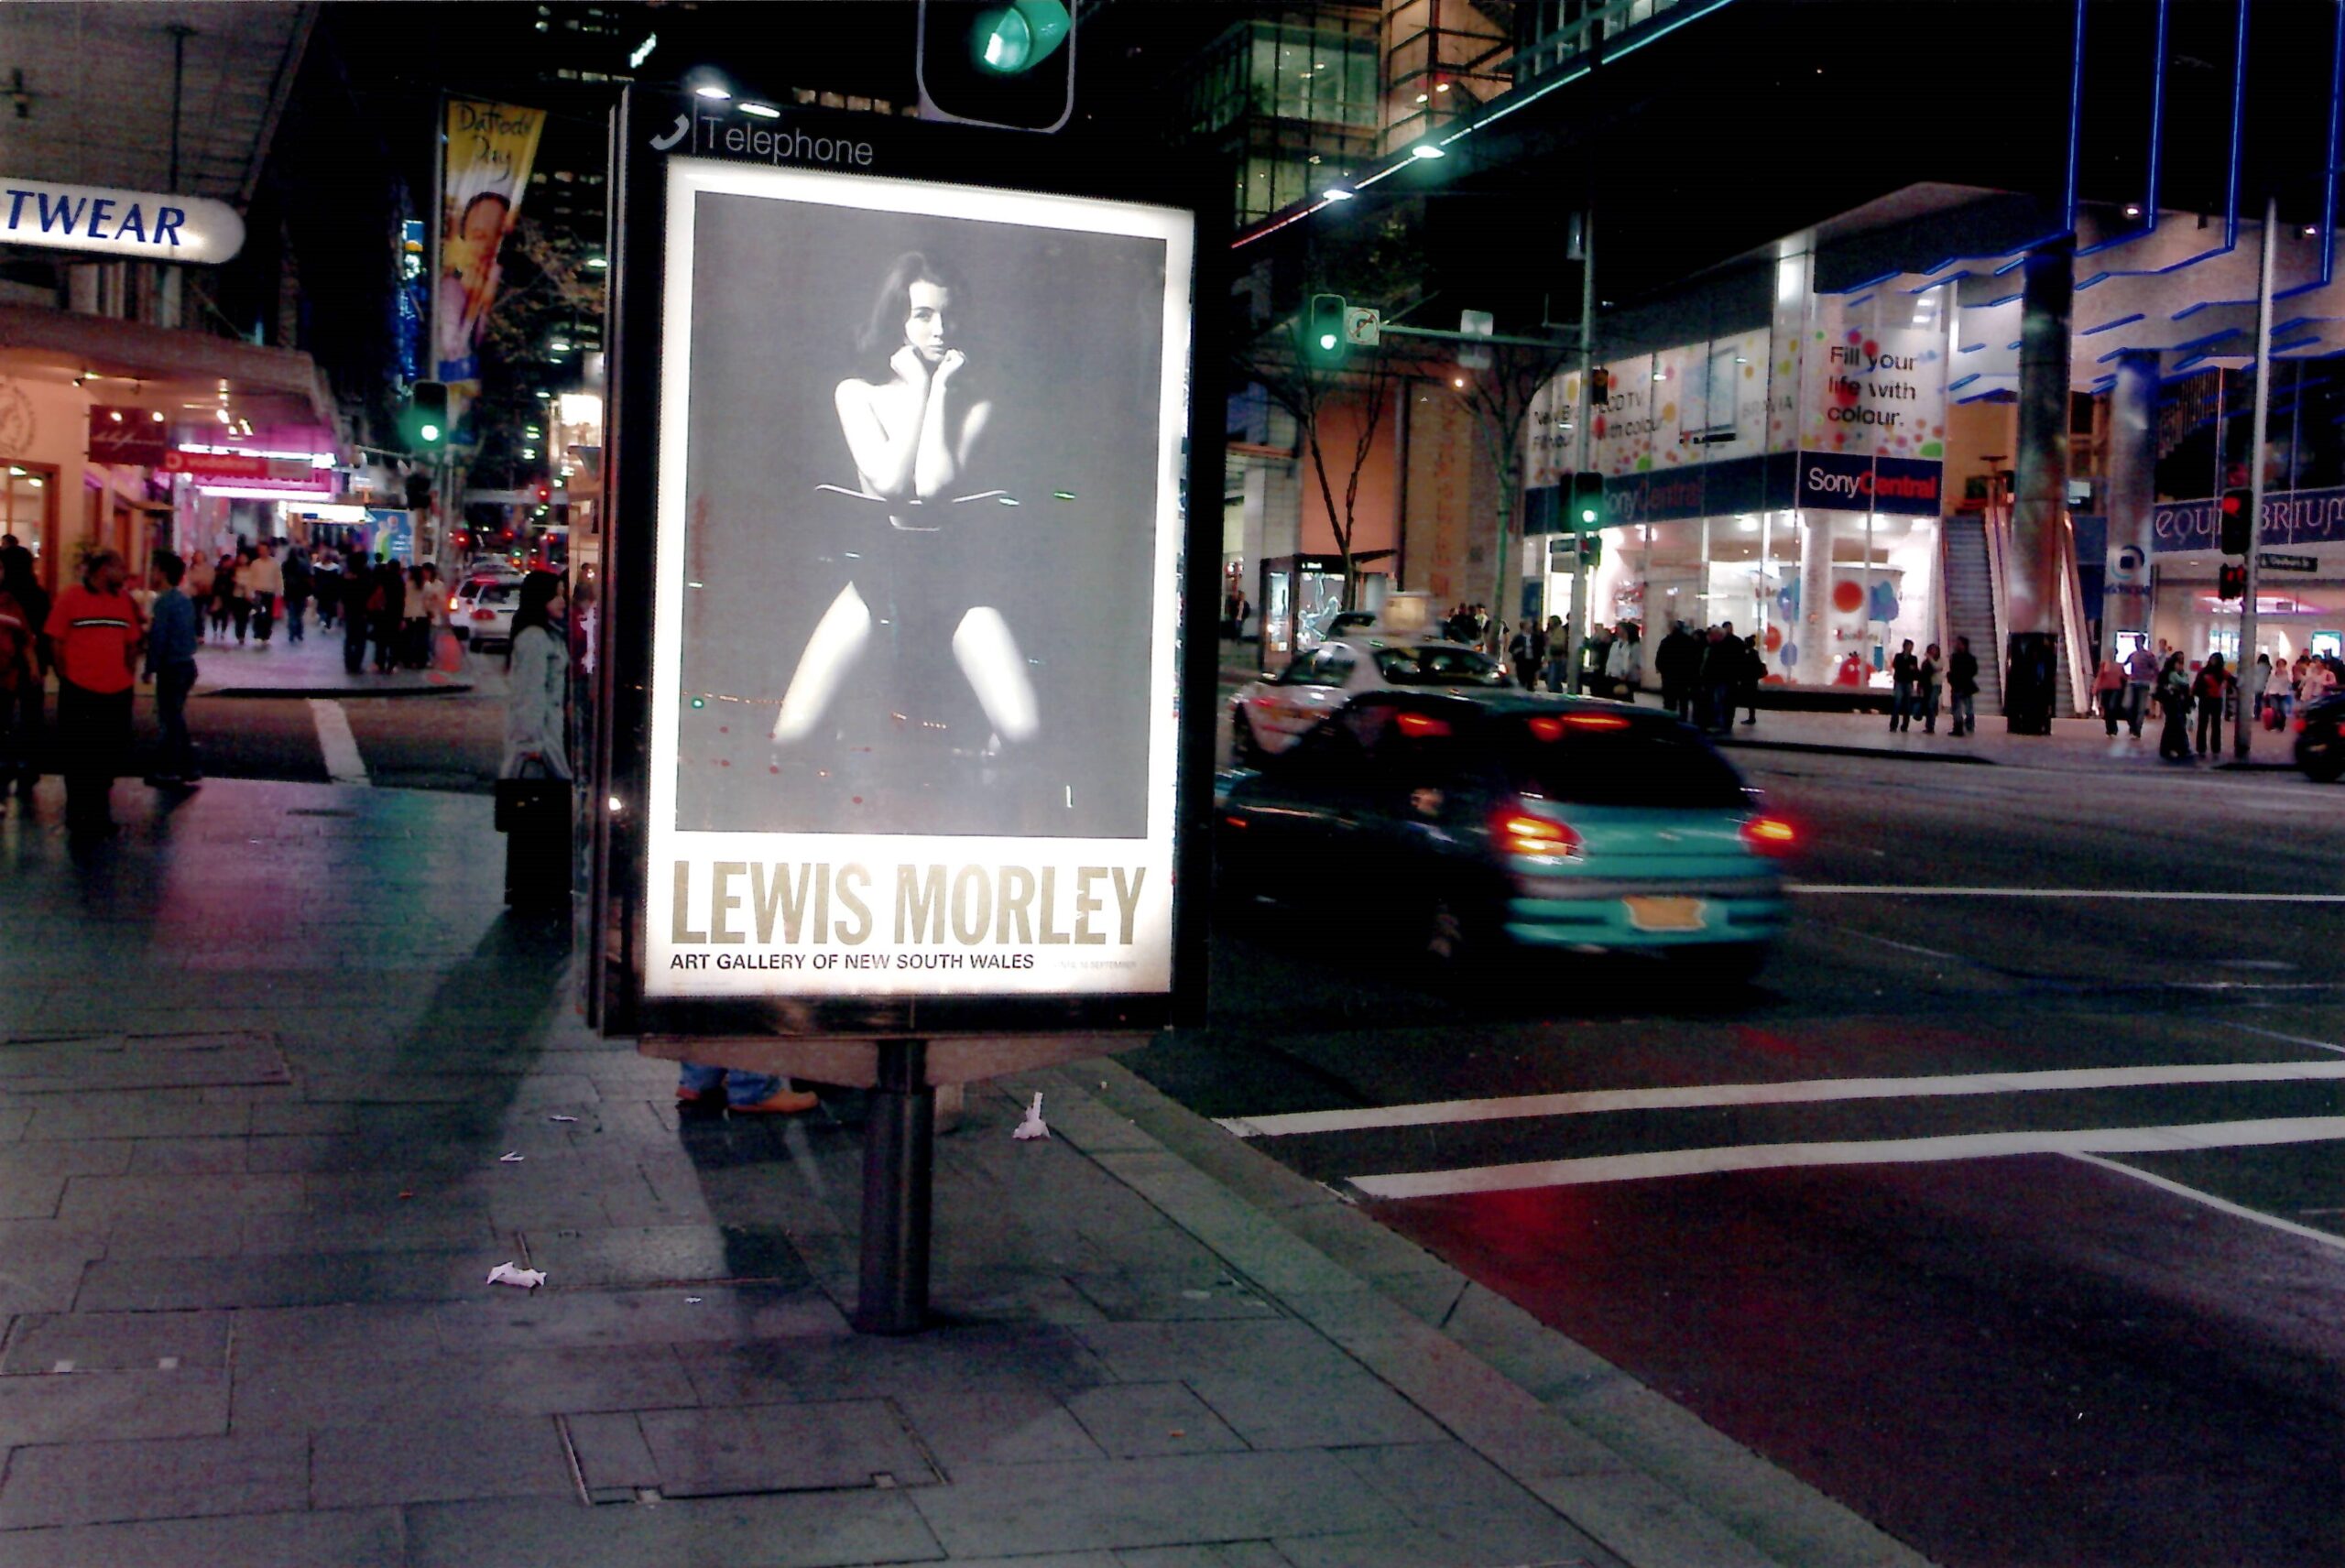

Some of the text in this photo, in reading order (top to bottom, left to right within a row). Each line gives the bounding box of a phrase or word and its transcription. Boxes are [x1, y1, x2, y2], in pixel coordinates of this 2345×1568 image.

[701, 115, 873, 167] Telephone
[6, 189, 185, 245] TWEAR
[1831, 345, 1917, 373] Fill your
[1829, 376, 1916, 400] life with
[1827, 405, 1903, 426] colour.
[671, 860, 1147, 945] LEWIS MORLEY
[670, 953, 1034, 970] ART GALLERY OF NEW SOUTH WALES
